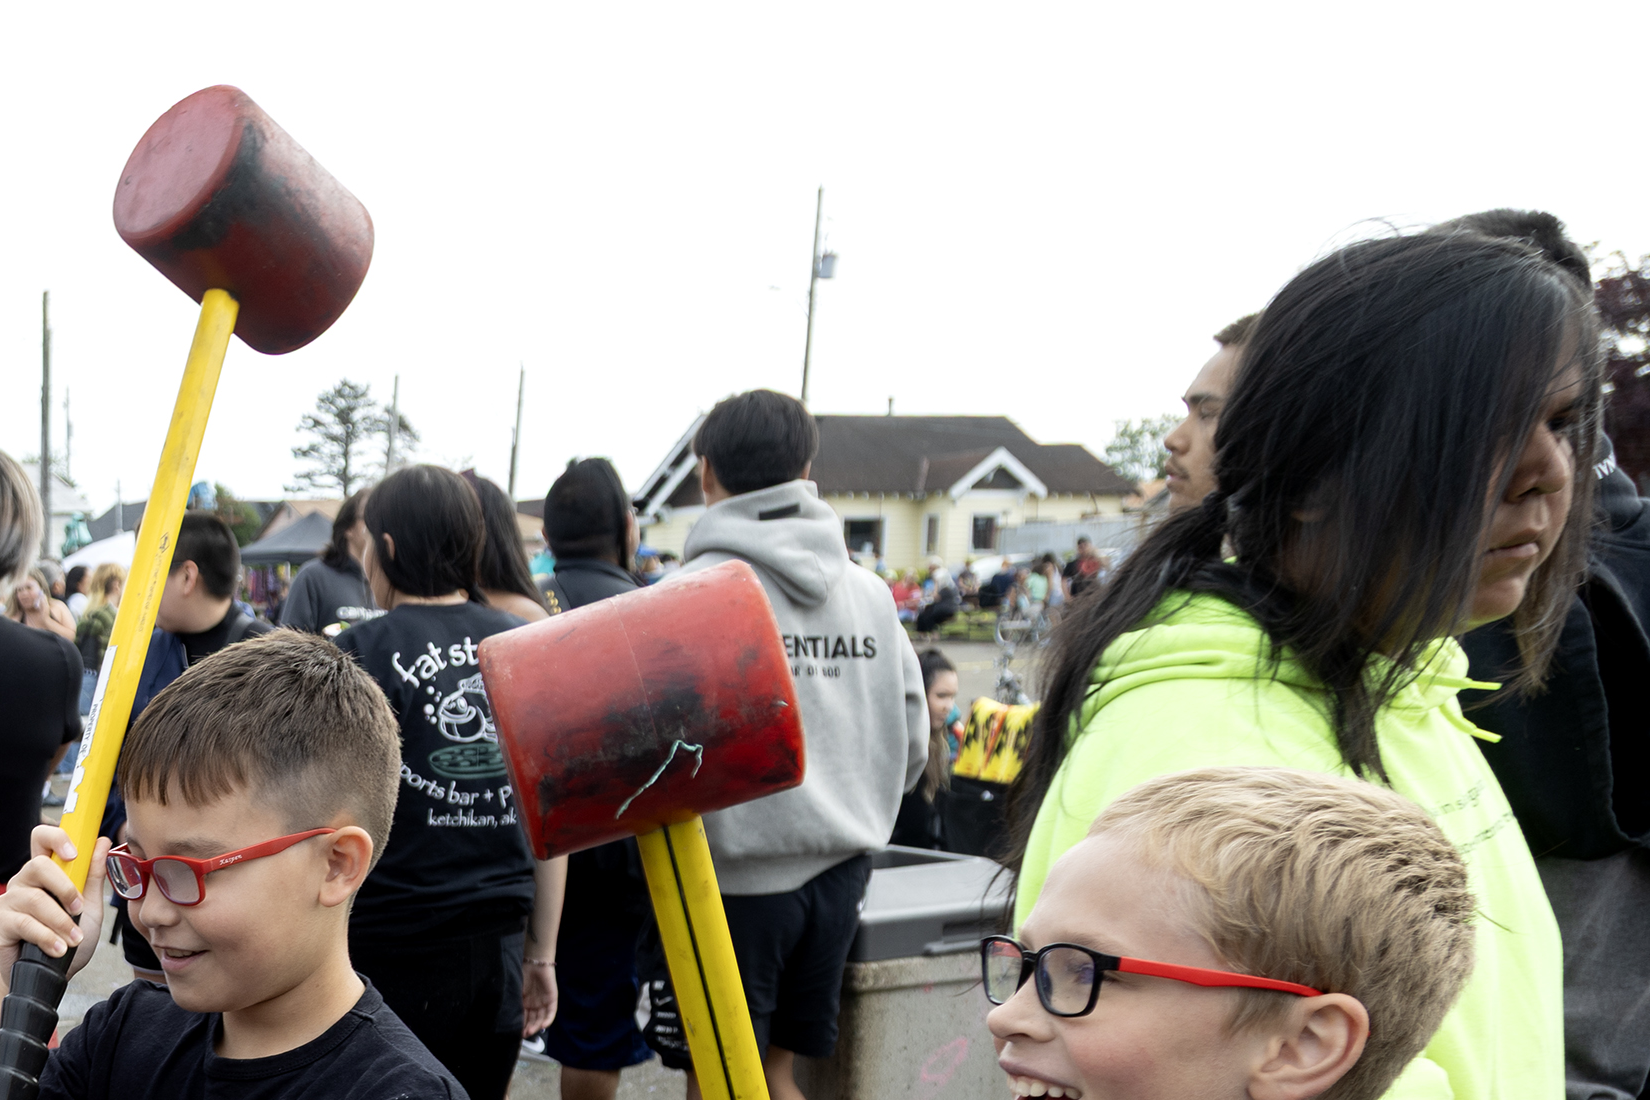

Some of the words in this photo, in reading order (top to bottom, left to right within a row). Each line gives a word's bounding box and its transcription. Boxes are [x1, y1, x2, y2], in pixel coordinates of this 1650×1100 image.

[391, 640, 448, 690] fat
[447, 635, 480, 668] st
[782, 634, 878, 659] ENTIALS
[400, 759, 446, 800] ports
[446, 780, 480, 806] bar
[497, 783, 513, 809] p
[426, 807, 498, 830] ketchikan,
[499, 806, 518, 828] ak
